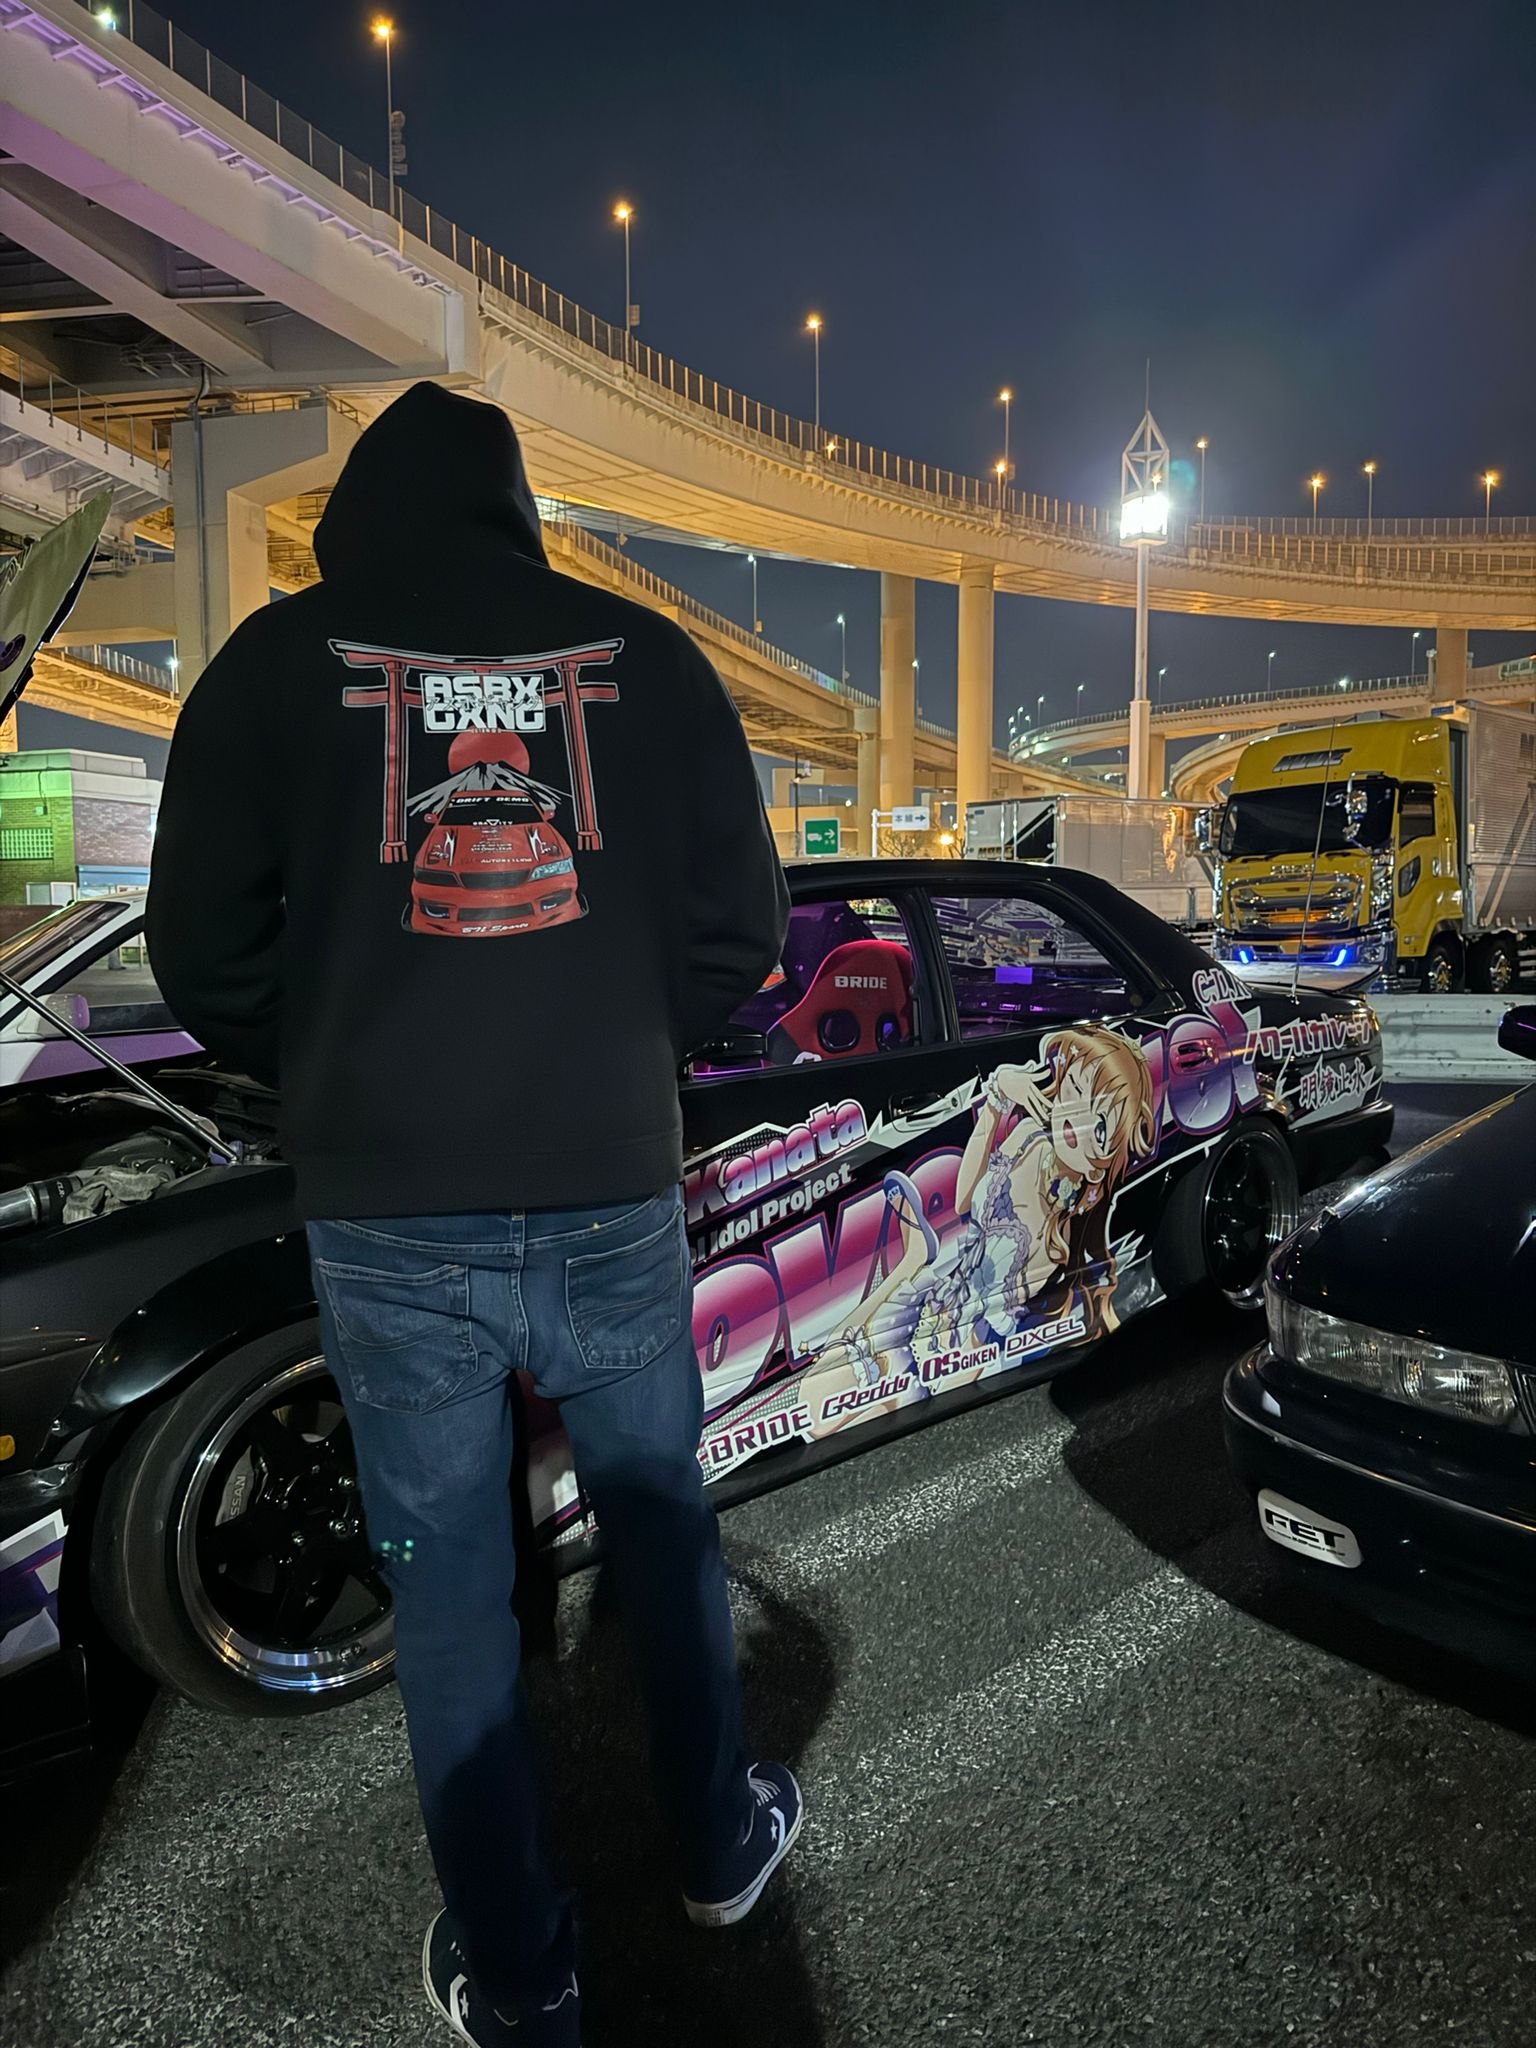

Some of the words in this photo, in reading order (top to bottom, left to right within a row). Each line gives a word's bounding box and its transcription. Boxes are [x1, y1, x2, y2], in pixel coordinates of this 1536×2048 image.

[834, 975, 887, 989] BRIDE
[1300, 1058, 1365, 1108] 明鏡止水
[686, 1102, 866, 1225] Kanata
[762, 1163, 851, 1228] Project
[711, 1404, 813, 1463] BRIDE
[822, 1374, 910, 1418] GReddy
[922, 1351, 961, 1383] OS
[961, 1347, 997, 1370] GIKEN
[1007, 1319, 1082, 1349] DIXCEL
[1264, 1508, 1346, 1548] FET
